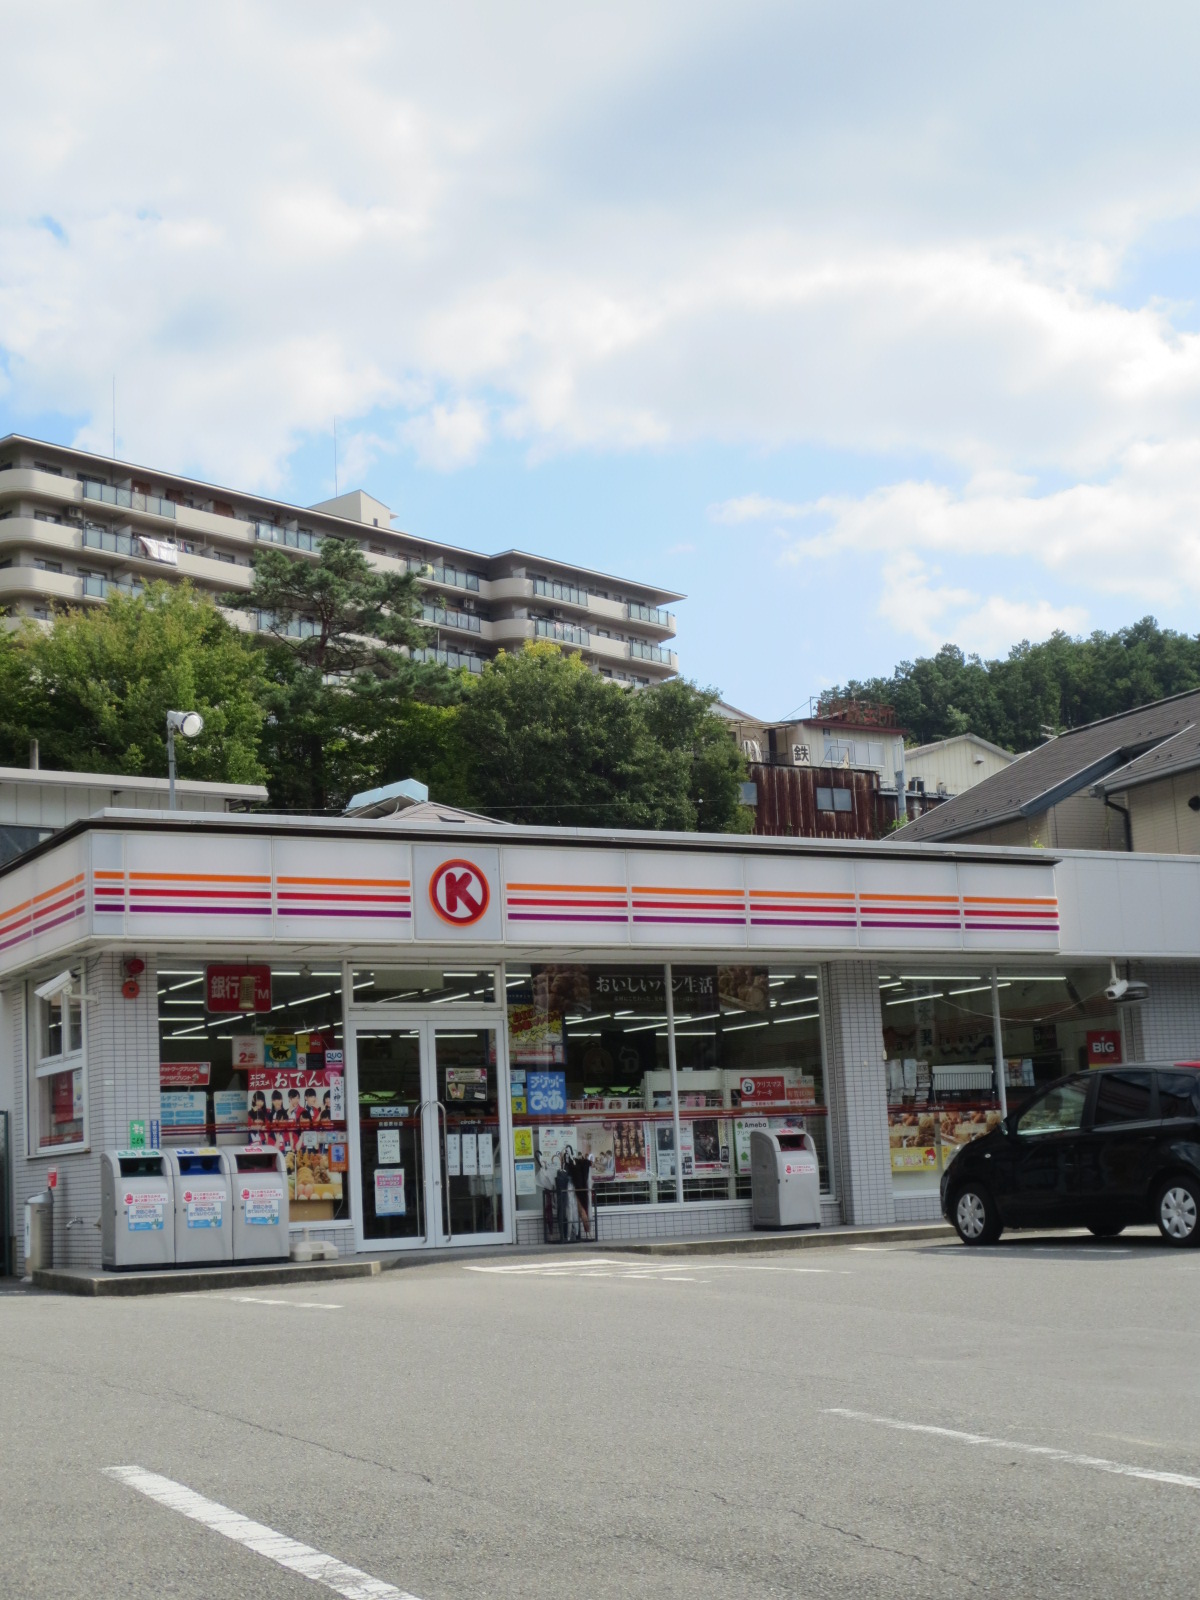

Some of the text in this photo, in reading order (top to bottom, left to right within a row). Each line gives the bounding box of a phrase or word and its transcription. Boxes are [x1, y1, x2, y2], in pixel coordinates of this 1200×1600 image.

[794, 746, 809, 762] 鉄
[211, 976, 240, 998] 銀行
[1092, 1042, 1114, 1052] BIG
[274, 1070, 321, 1088] おでん
[530, 1076, 563, 1088] チケット
[530, 1090, 564, 1110] ぴあ
